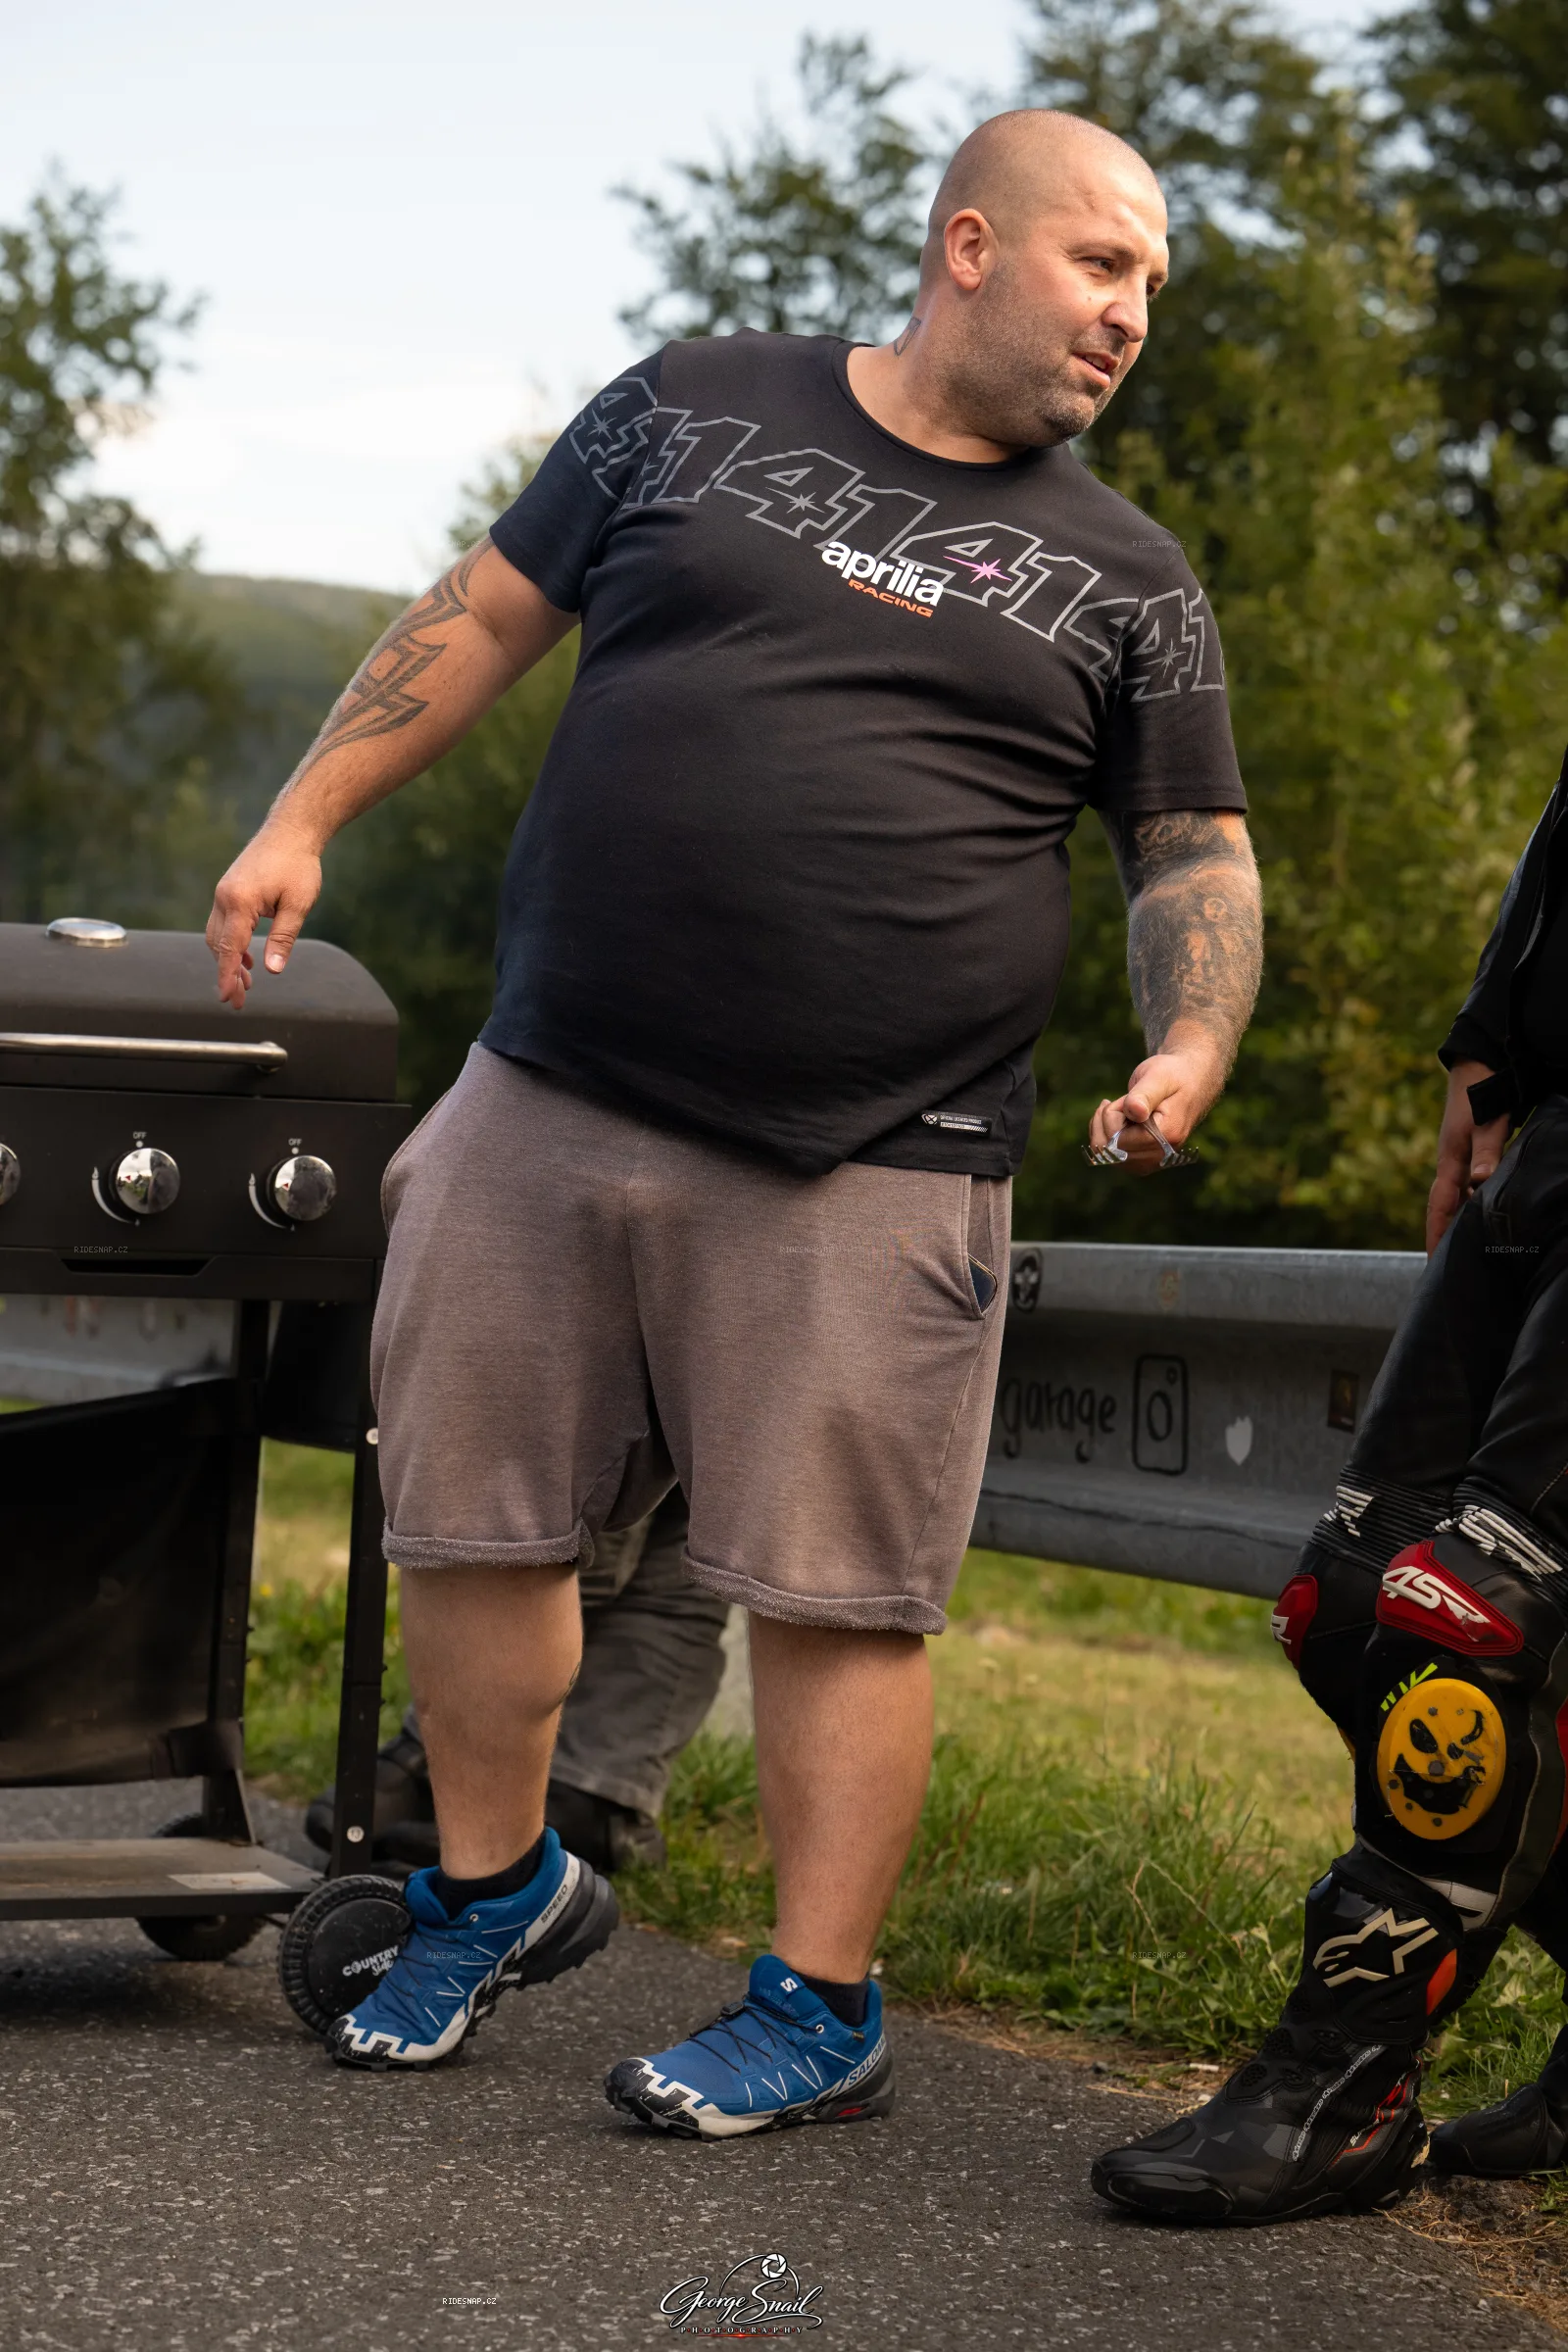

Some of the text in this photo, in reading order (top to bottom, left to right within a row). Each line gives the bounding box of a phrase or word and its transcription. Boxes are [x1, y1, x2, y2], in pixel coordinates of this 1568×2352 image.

[821, 541, 945, 607] aprilia
[848, 578, 934, 618] RACING
[132, 1131, 147, 1140] OFF
[288, 1138, 302, 1147] OFF
[1001, 1377, 1116, 1463] garage
[541, 1885, 567, 1923] SPEED
[342, 1945, 399, 1977] COUNTRY
